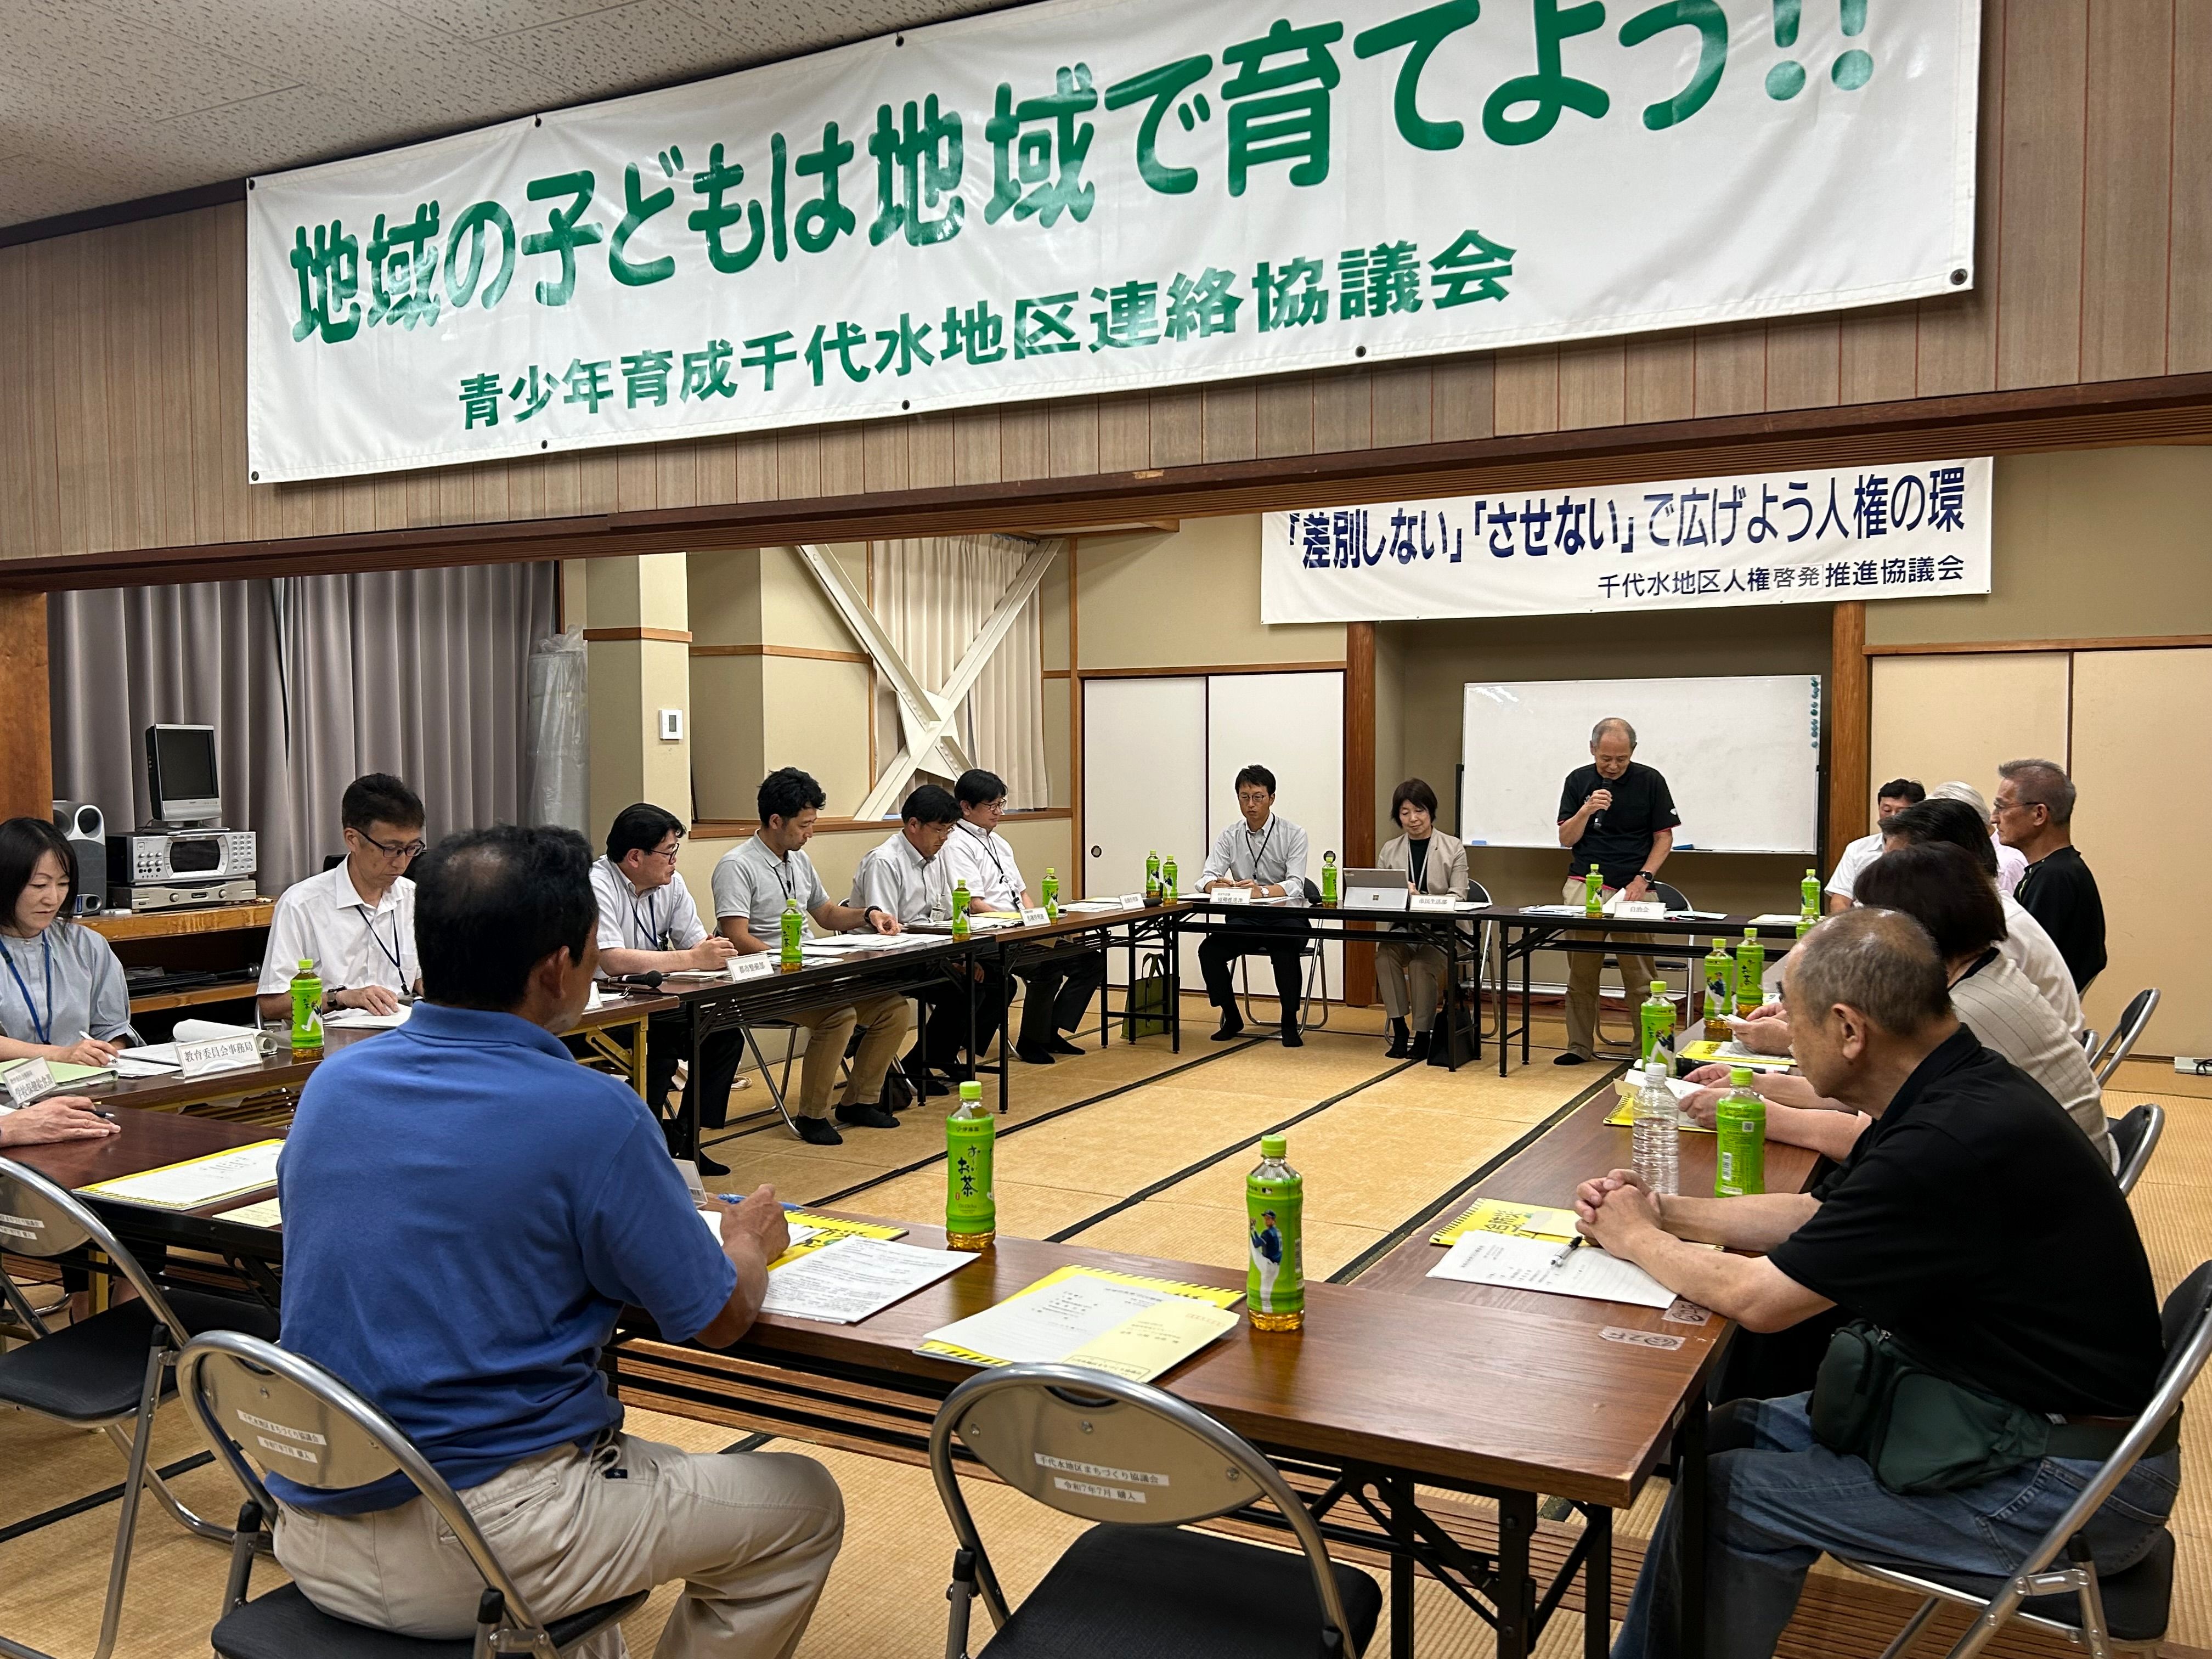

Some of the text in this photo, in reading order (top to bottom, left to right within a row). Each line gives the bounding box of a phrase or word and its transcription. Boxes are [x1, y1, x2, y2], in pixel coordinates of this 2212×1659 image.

[459, 229, 1516, 431] 青少年育成千代水地区連絡協議会
[1289, 467, 1965, 569] 「差別しない」「させない」で広げよう人権の環
[1598, 555, 1964, 598] 千代水地区人権啓発推進協議会
[185, 1042, 253, 1063] 教育委員会事務局
[1041, 1456, 1159, 1484] 千代水地区まちづくり協議会
[1117, 1490, 1136, 1500] 購入
